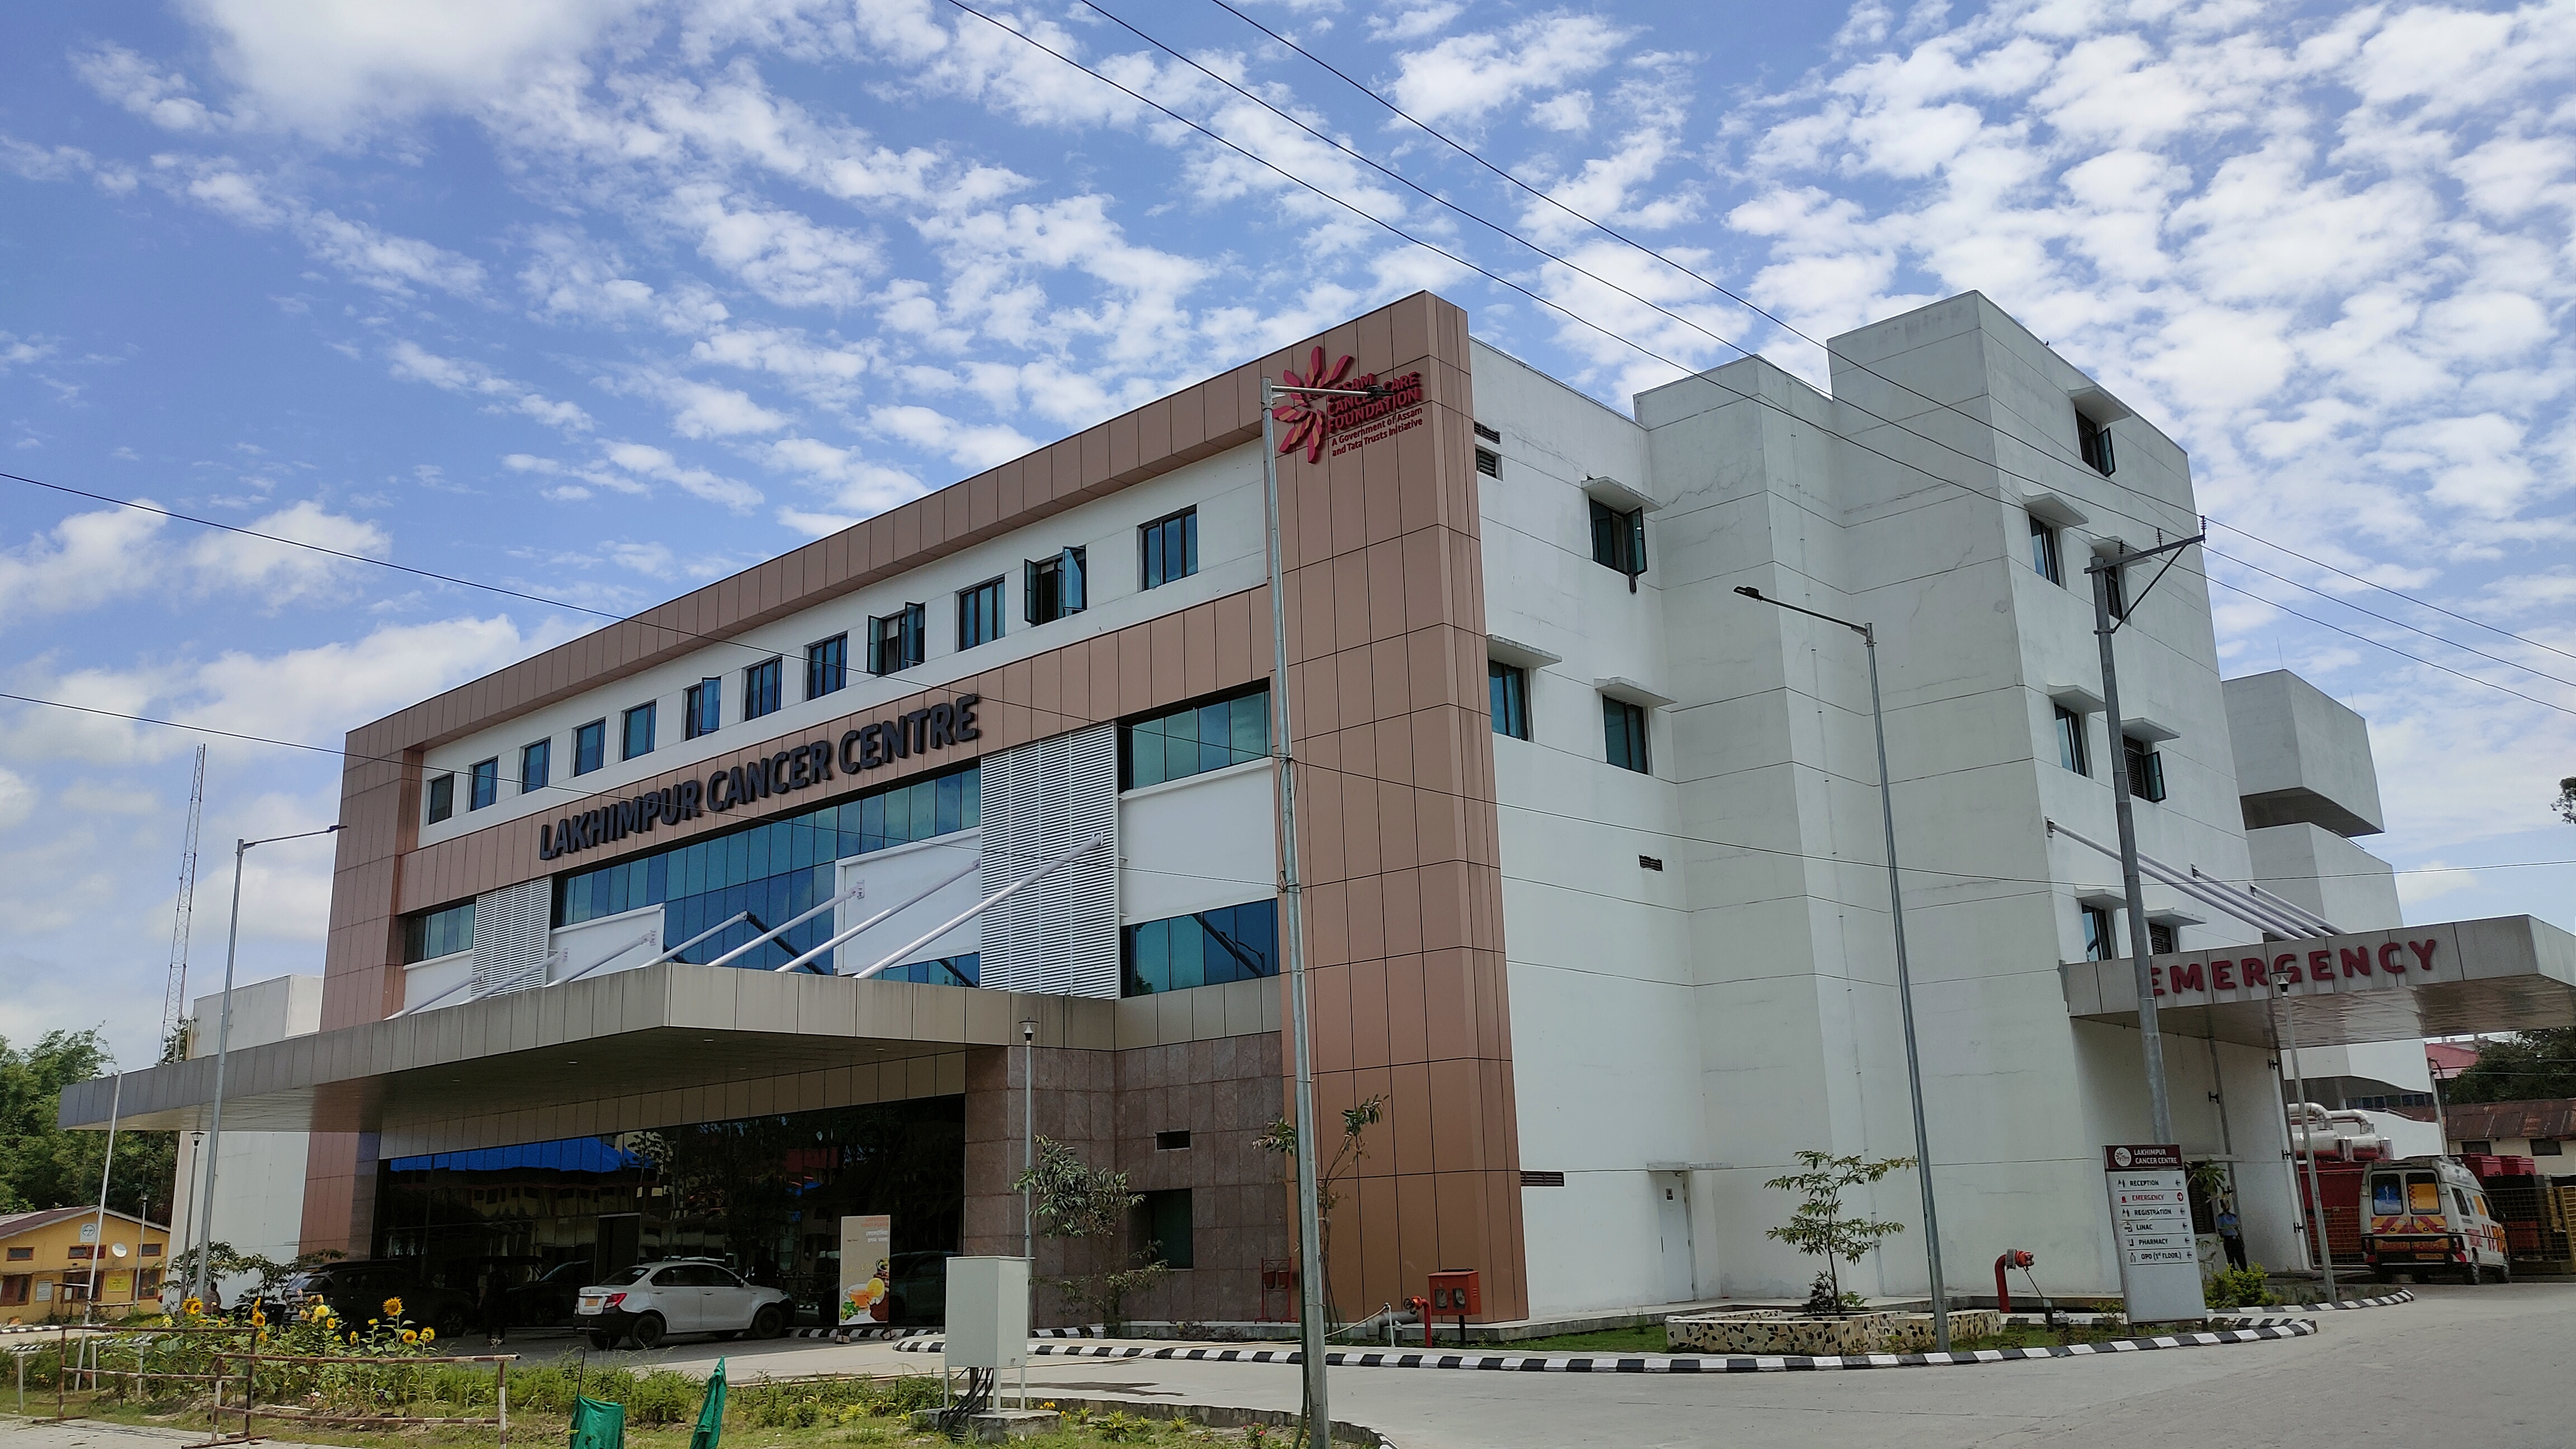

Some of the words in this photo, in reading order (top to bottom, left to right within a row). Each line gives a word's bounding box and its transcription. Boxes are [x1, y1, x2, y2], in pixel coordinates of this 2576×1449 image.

[1383, 372, 1420, 391] CARE
[1328, 387, 1422, 434] FOUNDATION
[1332, 438, 1337, 447] A
[1339, 421, 1386, 443] Government
[1387, 417, 1396, 426] of
[1397, 408, 1423, 423] Assam
[1332, 444, 1346, 457] and
[1347, 440, 1362, 451] Tata
[1363, 430, 1388, 445] Trusts
[1389, 418, 1423, 437] Initiative
[539, 779, 702, 860] LAKHIMPUR
[707, 740, 832, 812] CANCER
[839, 693, 981, 775] CENTRE
